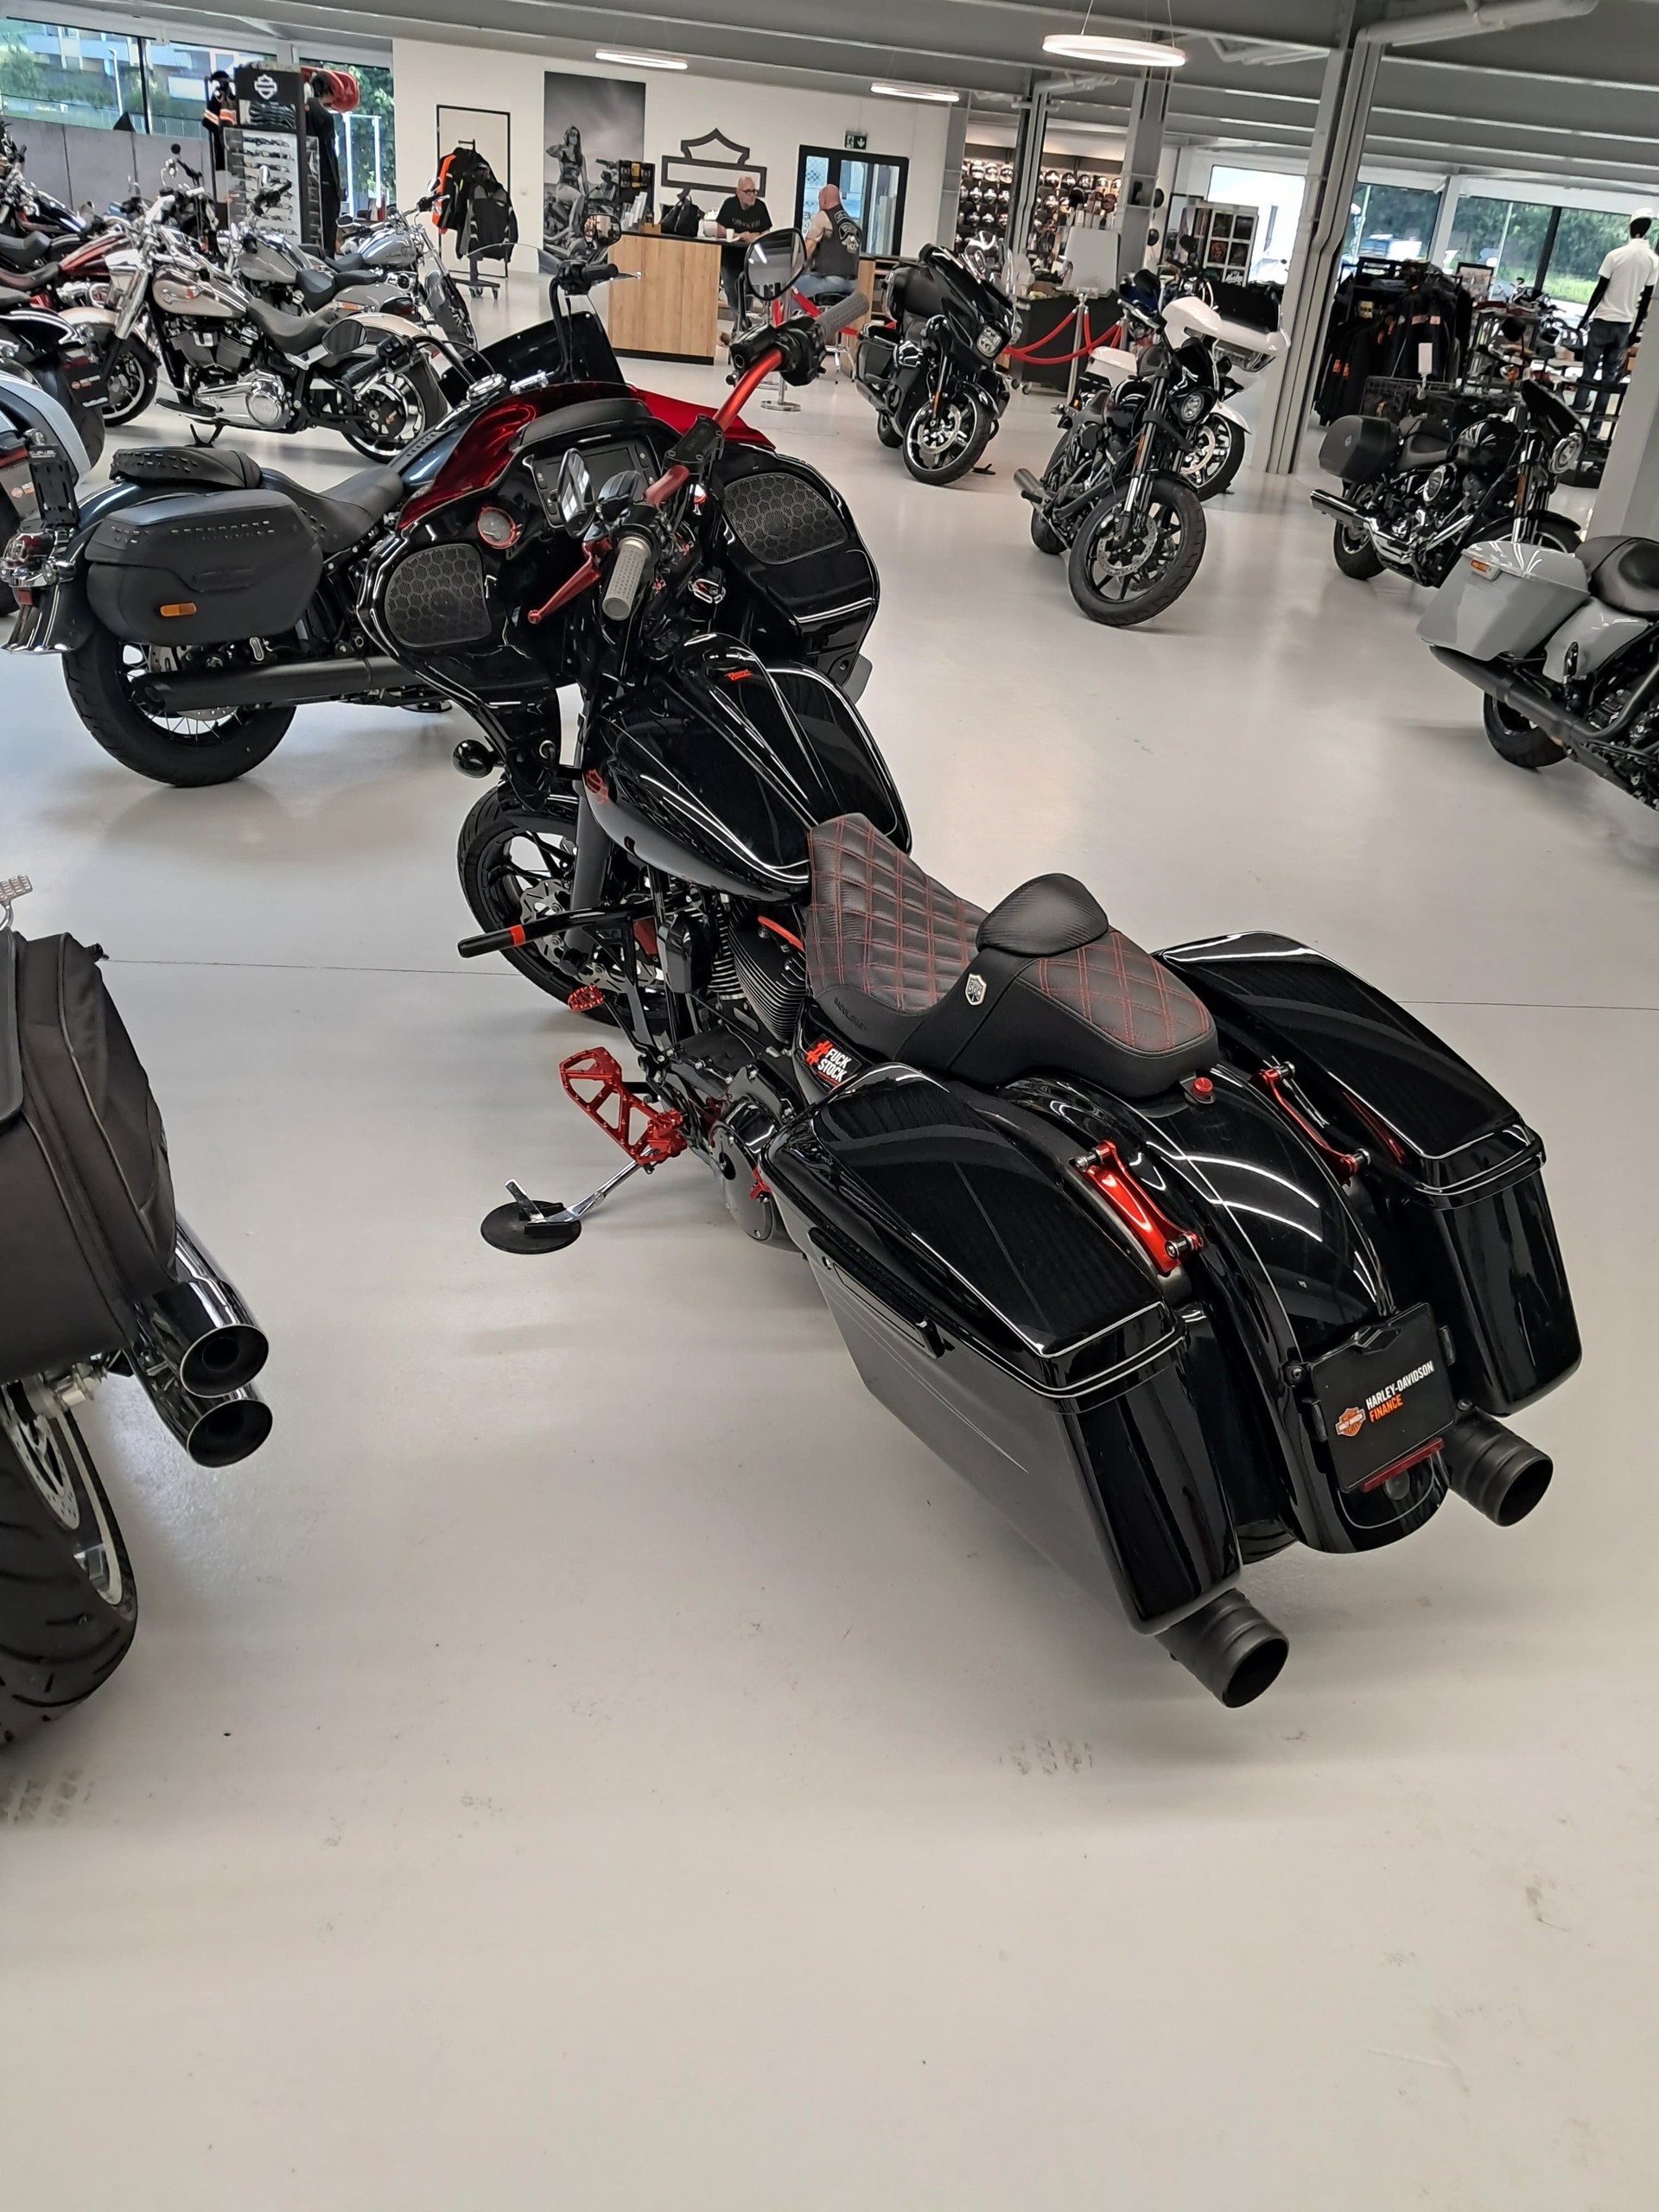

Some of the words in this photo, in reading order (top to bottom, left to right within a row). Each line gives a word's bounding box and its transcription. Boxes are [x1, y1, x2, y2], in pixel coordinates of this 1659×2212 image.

[817, 1058, 847, 1083] STOCK
[1365, 1360, 1434, 1410] HARLEY-DAVIDSON
[1369, 1394, 1403, 1423] FINANCE
